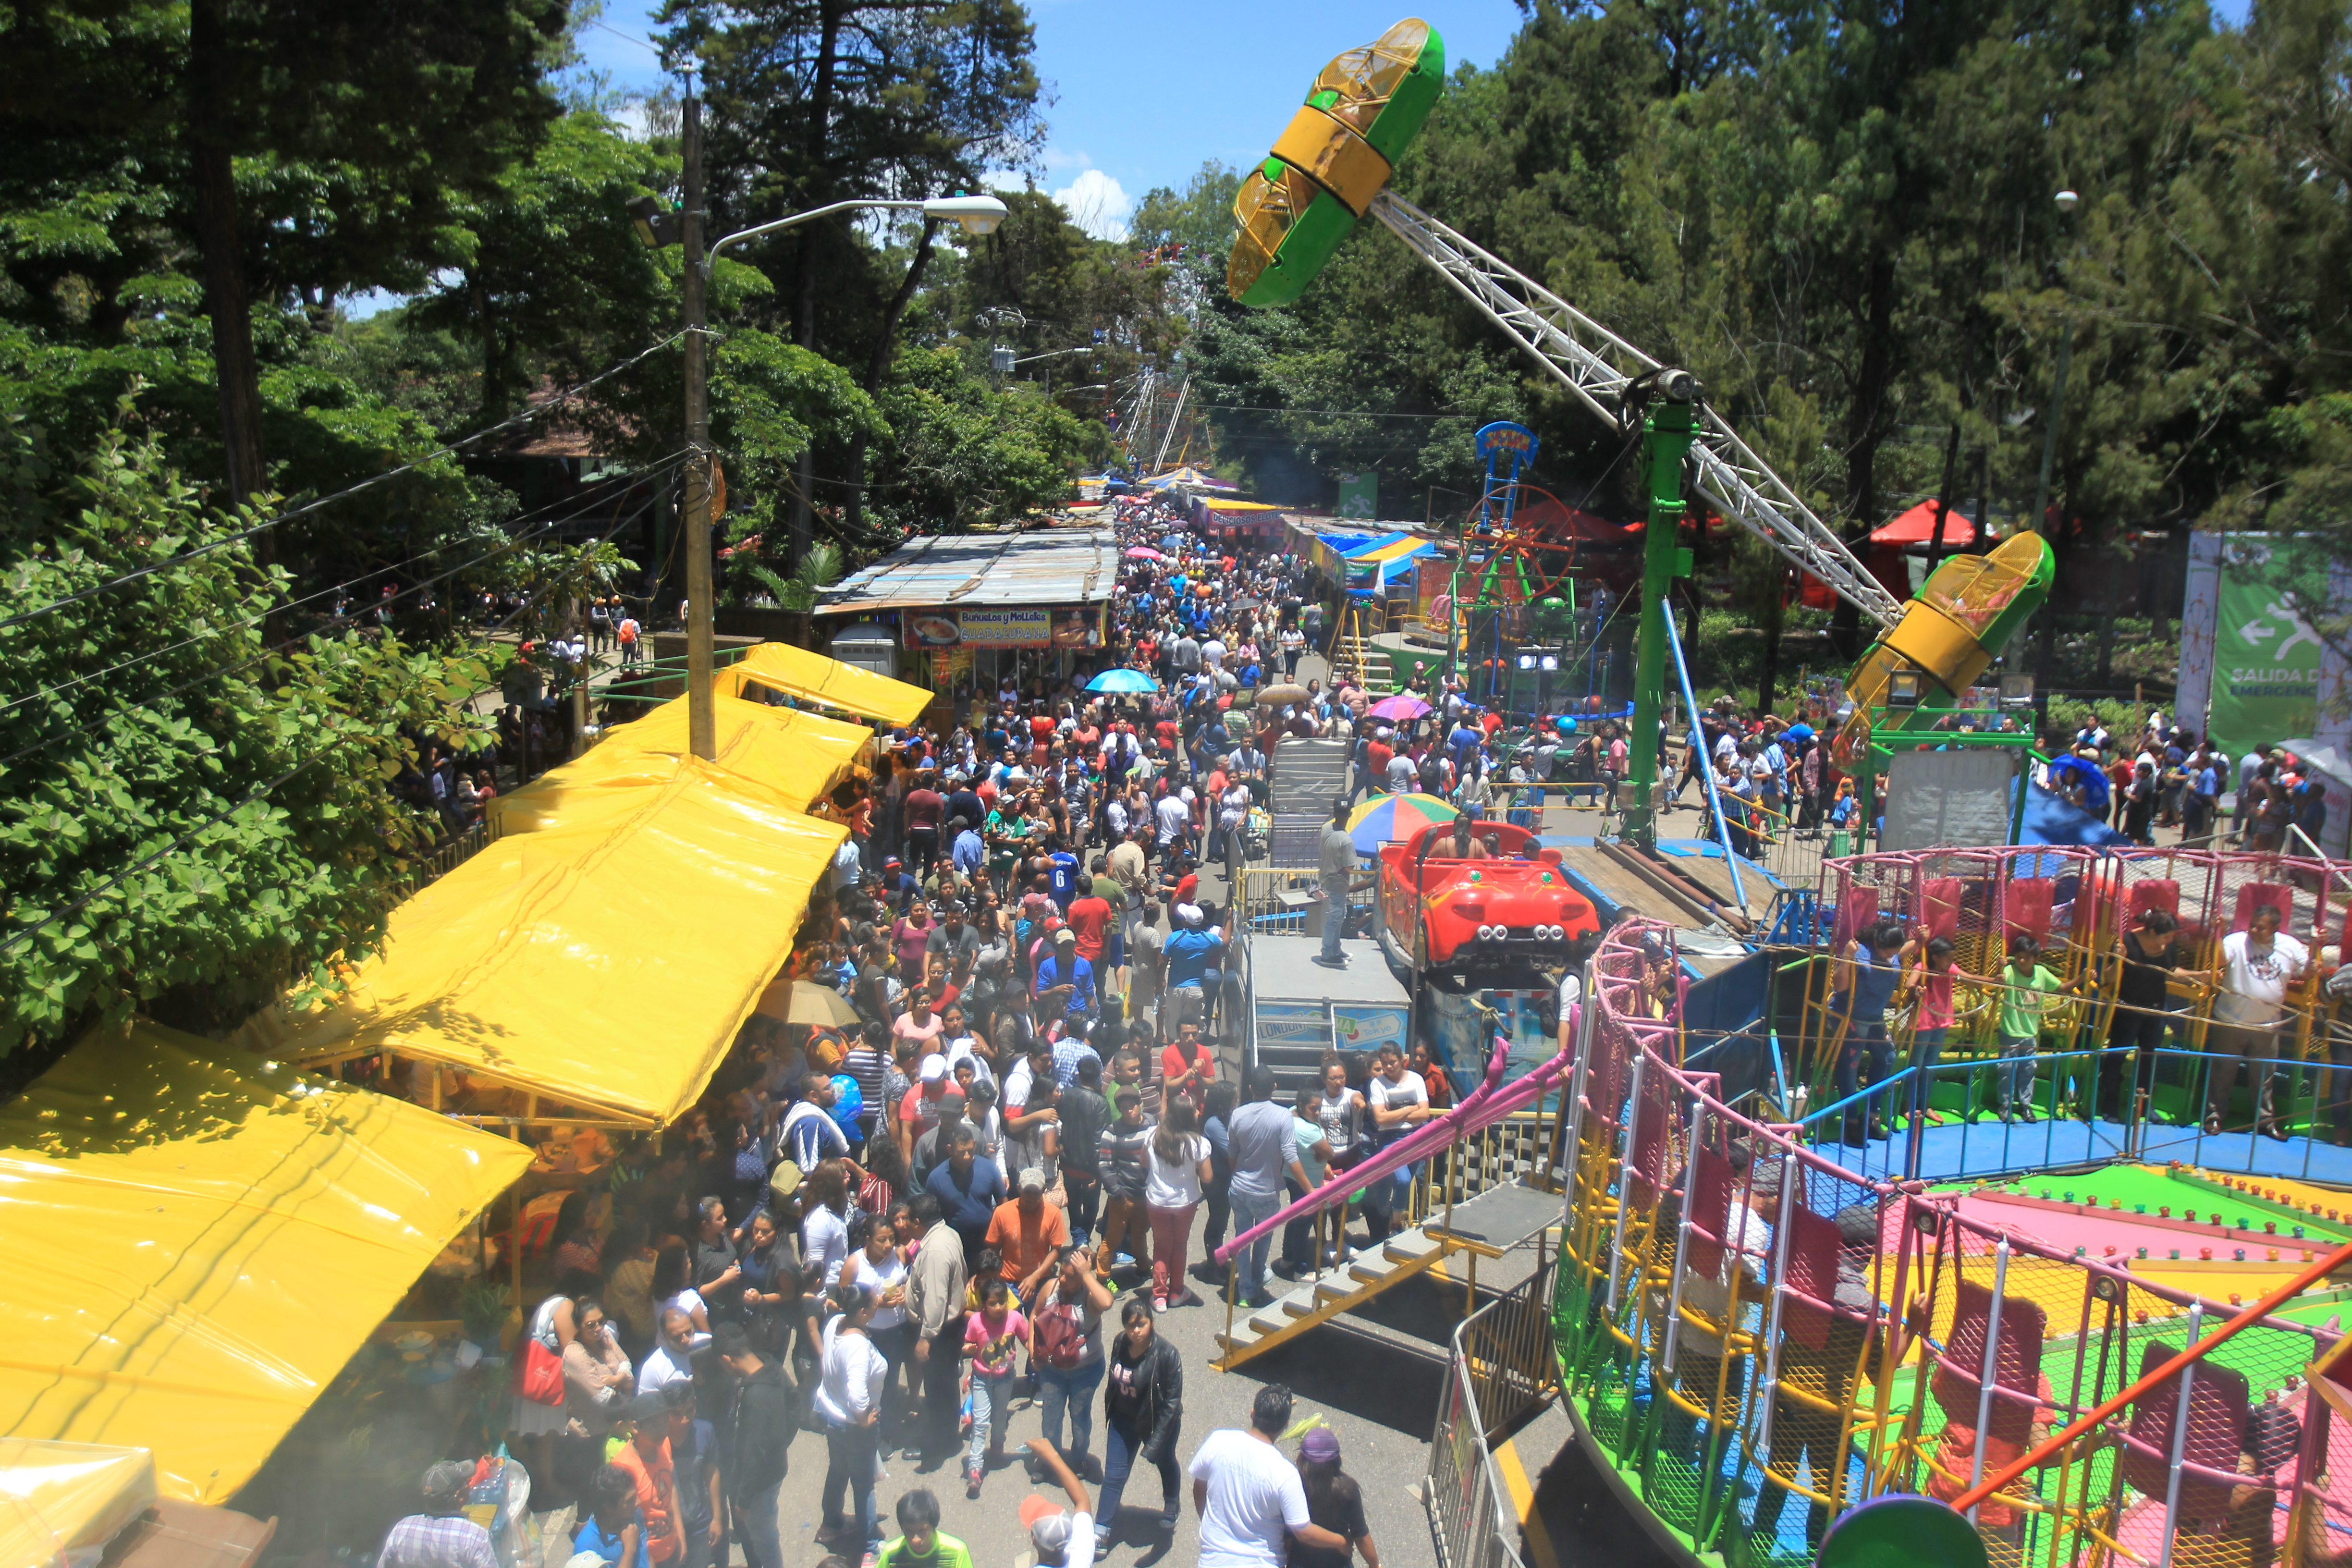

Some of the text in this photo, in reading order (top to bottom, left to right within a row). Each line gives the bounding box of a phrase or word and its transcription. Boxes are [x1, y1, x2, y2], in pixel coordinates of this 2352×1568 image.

[1213, 511, 1255, 525] DELICIOSOS
[1002, 613, 1008, 625] y
[961, 626, 1050, 642] GUADALUPANA
[2230, 668, 2319, 683] SALIDA D
[2230, 685, 2317, 697] EMERGENC
[1056, 870, 1065, 887] 6
